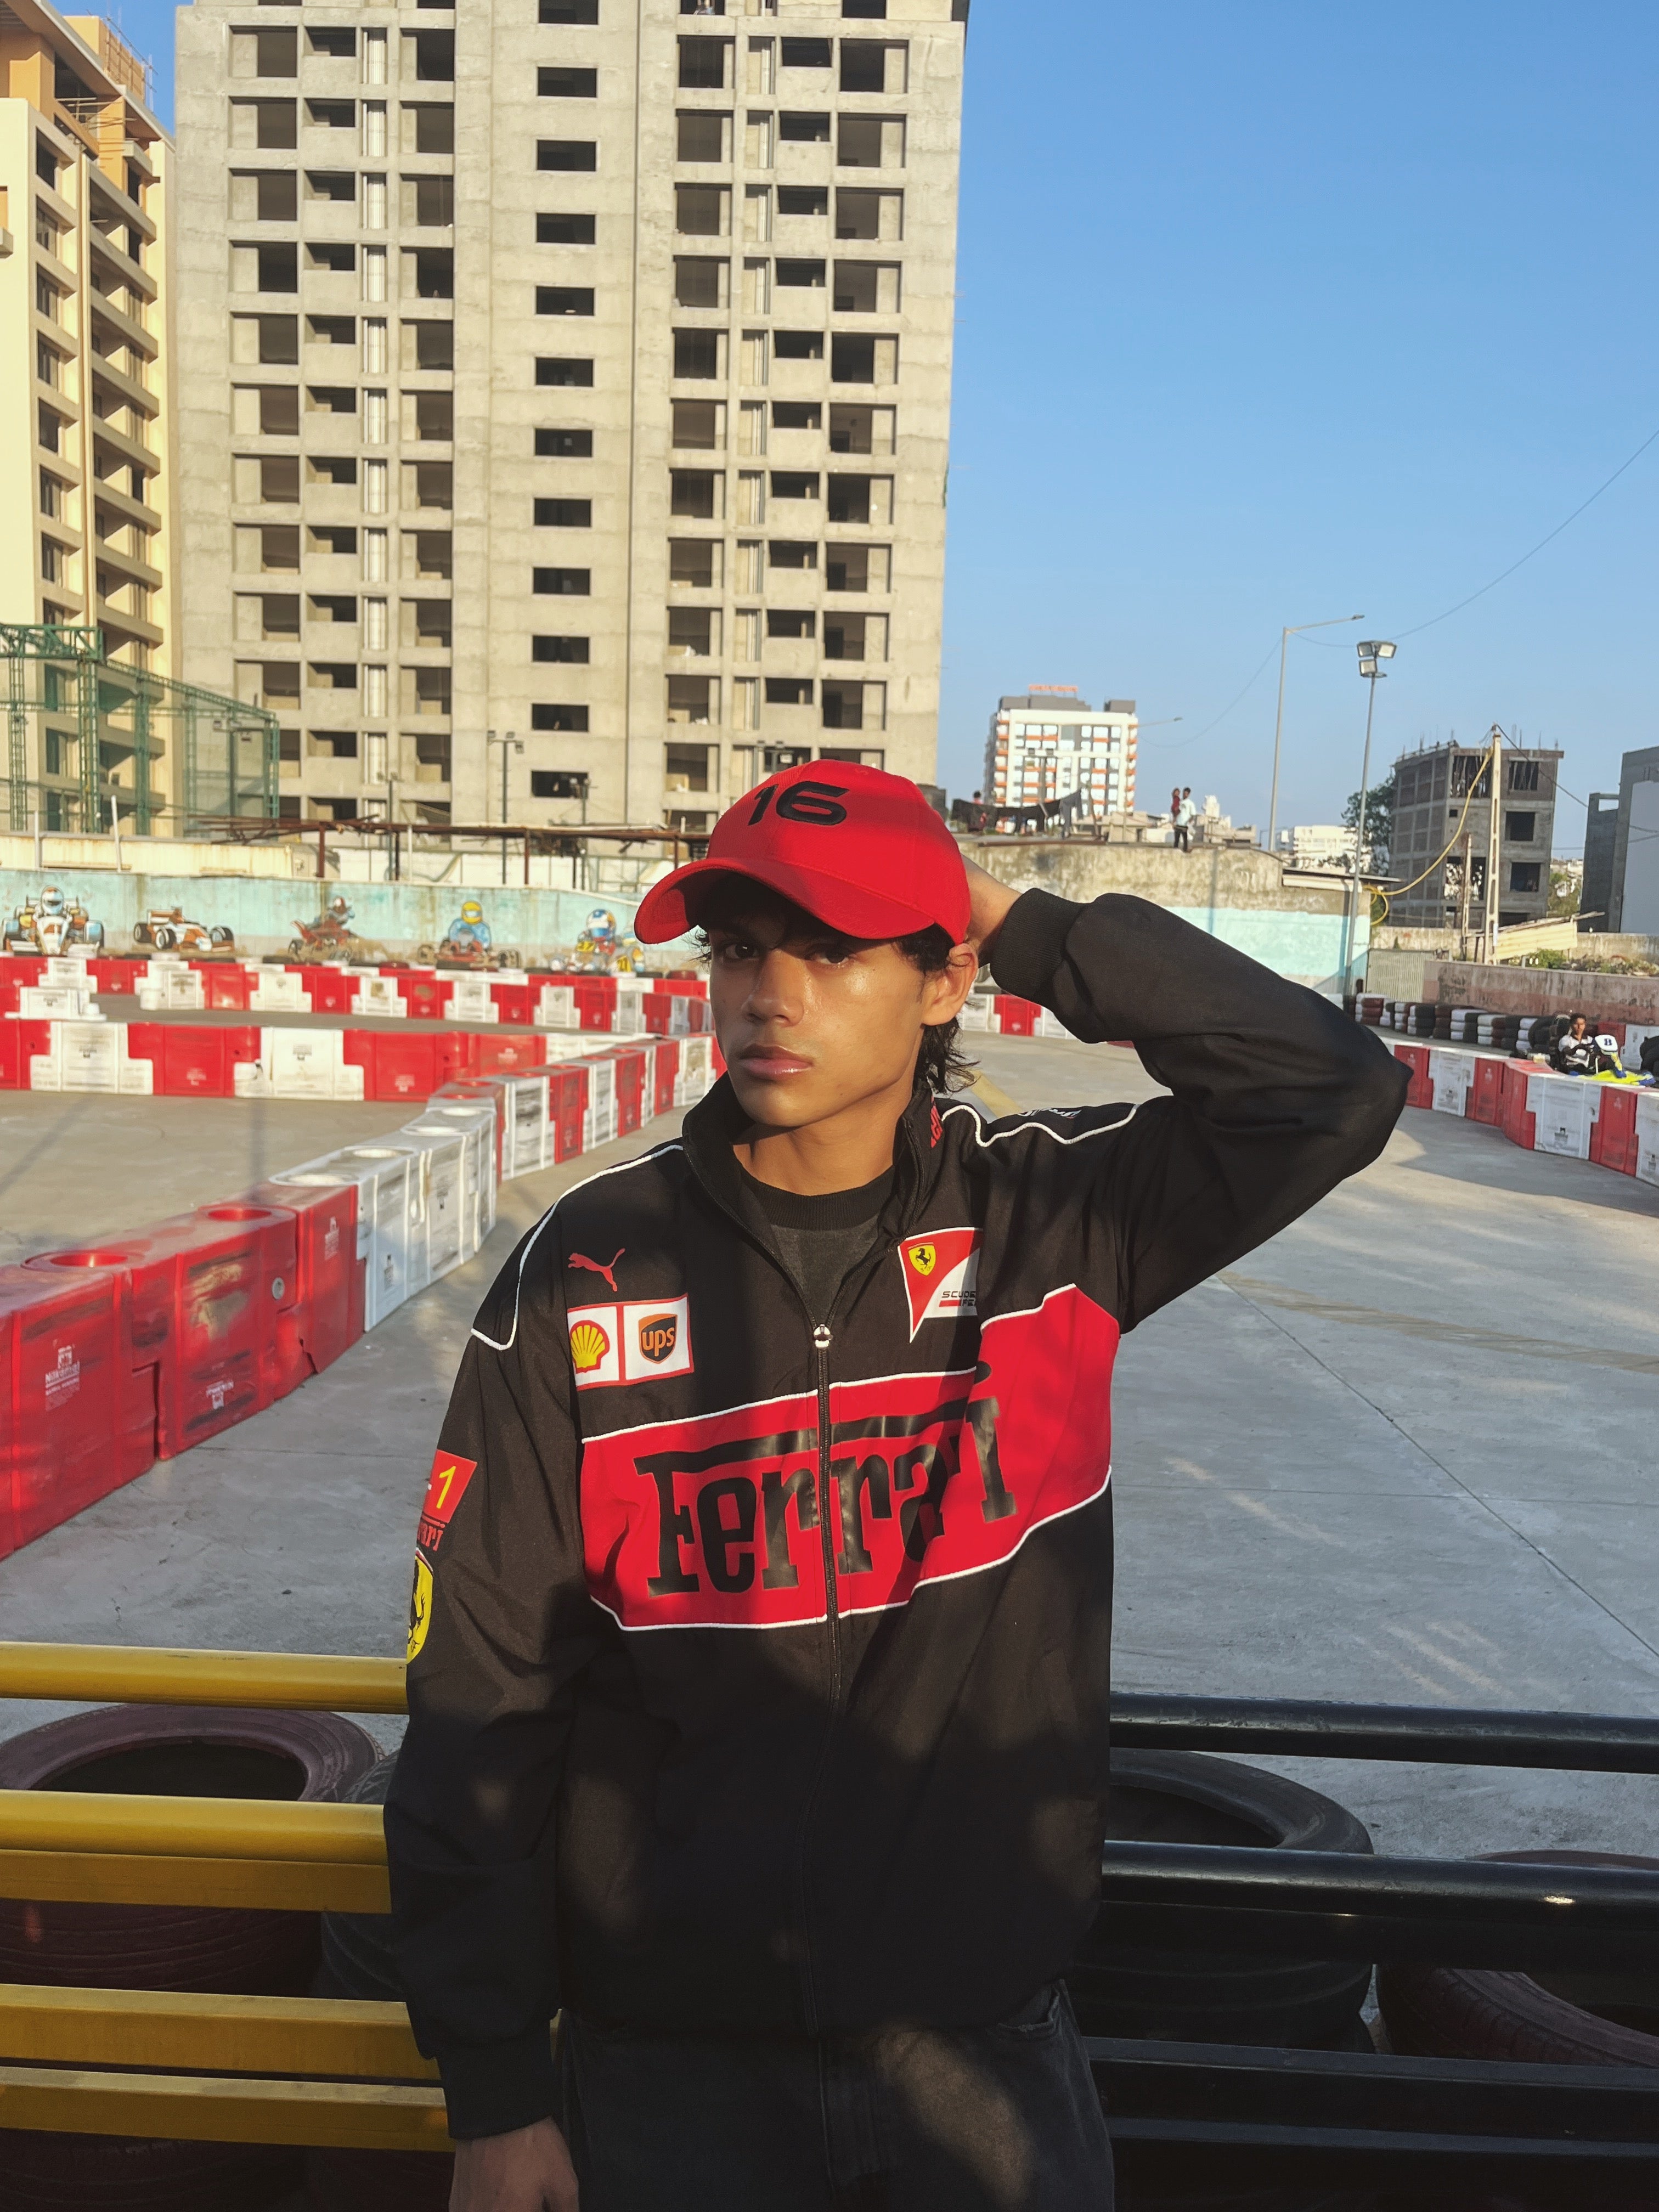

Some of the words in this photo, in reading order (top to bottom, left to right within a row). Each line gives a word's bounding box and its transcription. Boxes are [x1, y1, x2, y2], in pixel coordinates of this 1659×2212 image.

[748, 781, 850, 826] 16
[642, 1327, 675, 1357] ups
[634, 1361, 1018, 1598] Ferrai
